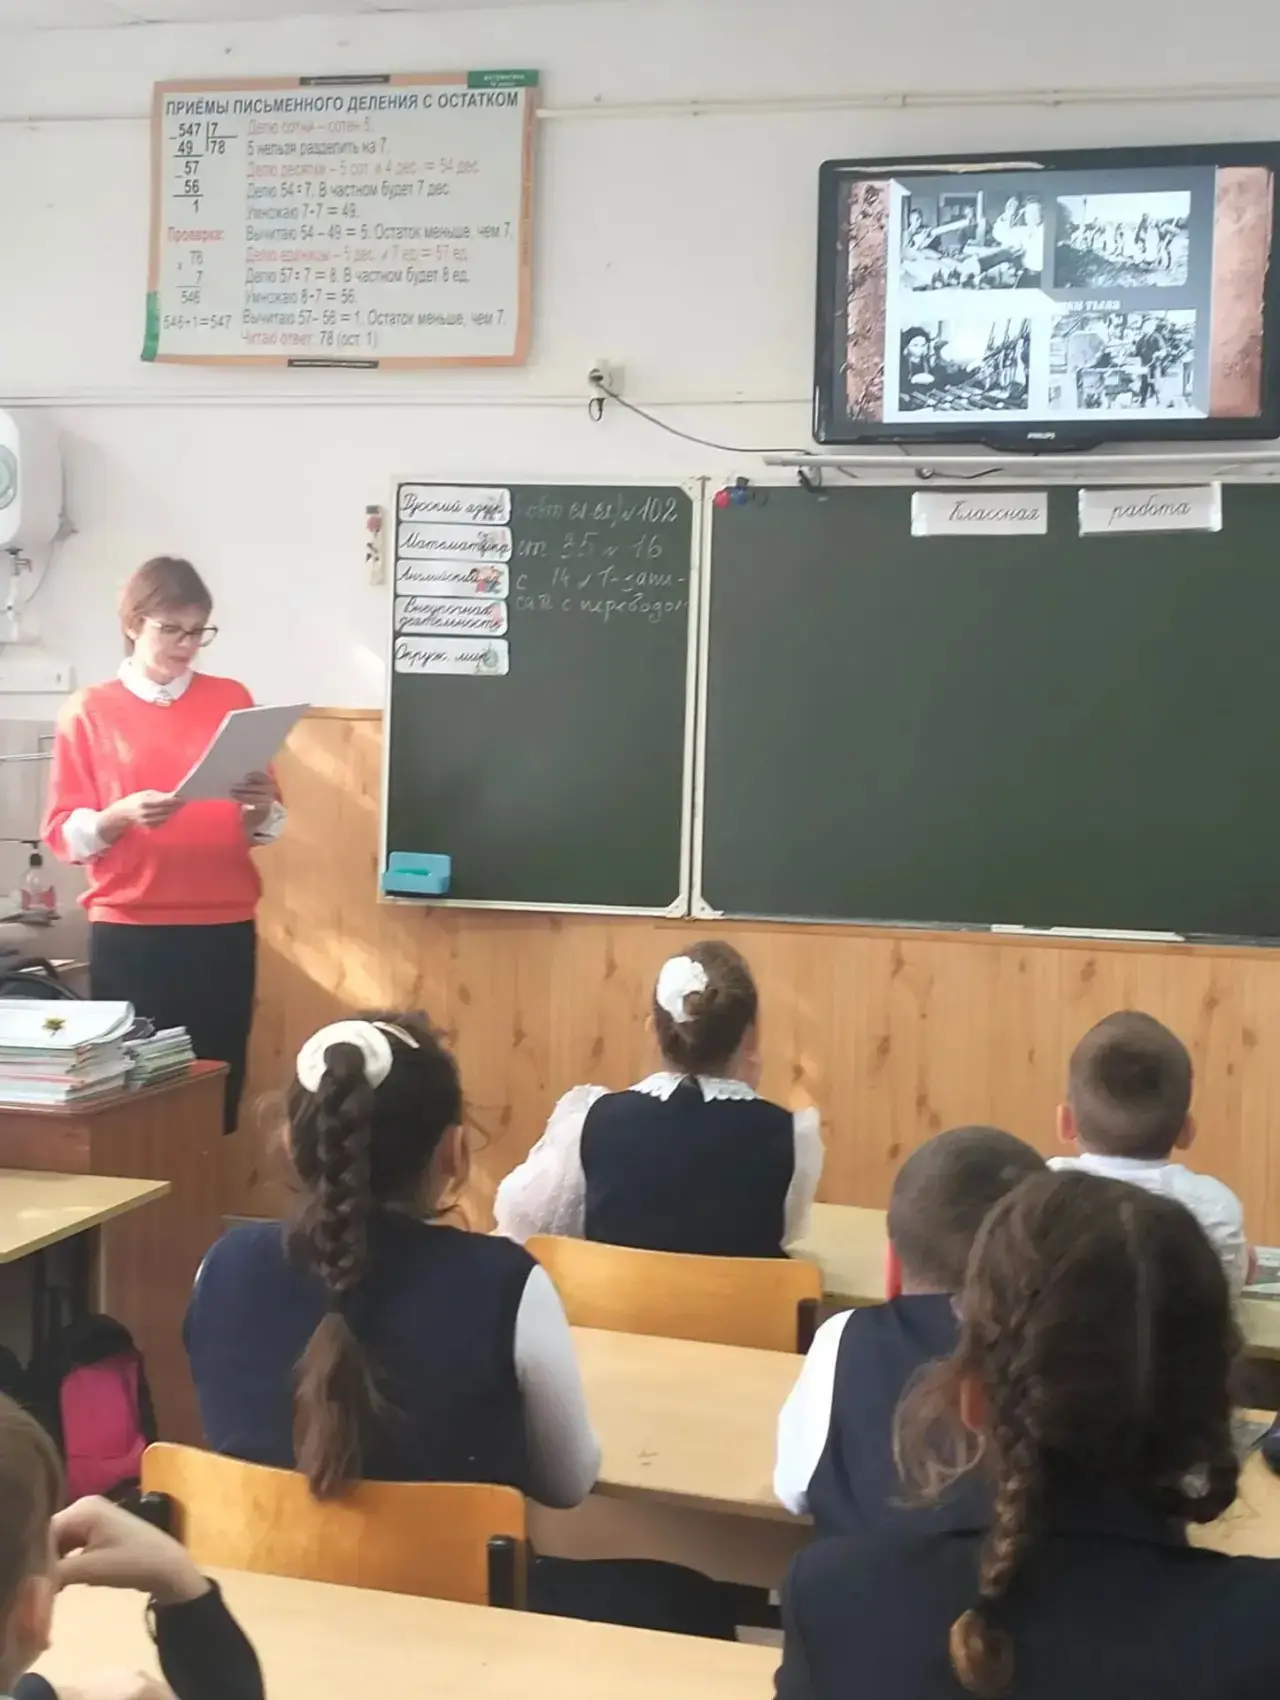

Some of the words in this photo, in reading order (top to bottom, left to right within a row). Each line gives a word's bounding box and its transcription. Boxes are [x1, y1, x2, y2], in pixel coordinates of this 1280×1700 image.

[166, 97, 228, 115] ПРИЁМЫ
[233, 96, 343, 114] ПИСЬМЕННОГО
[347, 94, 418, 113] ДЕЛЕНИЯ
[423, 94, 433, 108] С
[438, 91, 518, 108] ОСТАТКОМ
[179, 122, 201, 137] 547
[178, 141, 193, 156] 49
[210, 140, 226, 154] 78
[184, 160, 200, 175] 57
[184, 179, 200, 194] 56
[949, 500, 1040, 522] Классная
[1108, 493, 1192, 527] работа
